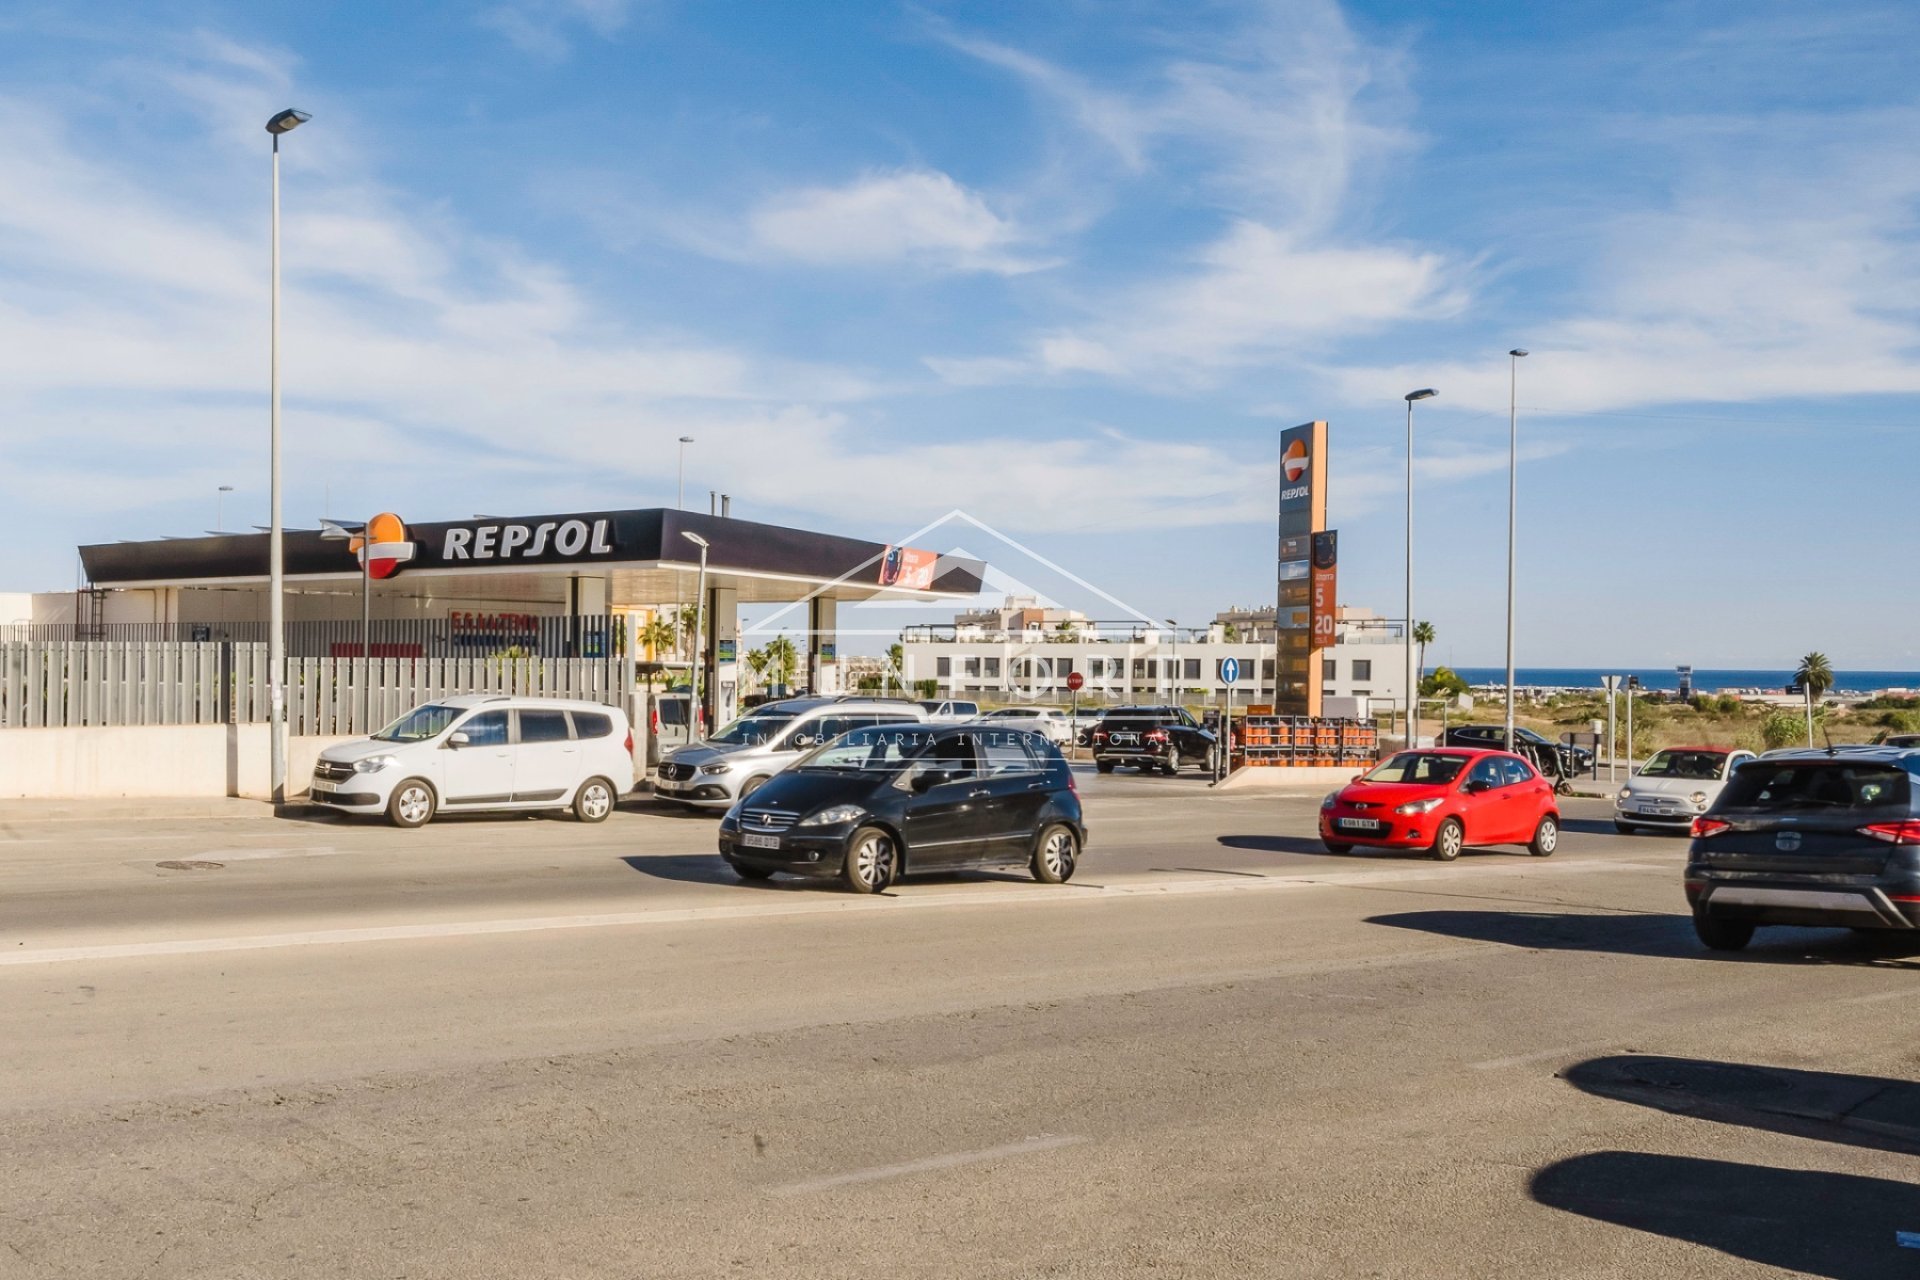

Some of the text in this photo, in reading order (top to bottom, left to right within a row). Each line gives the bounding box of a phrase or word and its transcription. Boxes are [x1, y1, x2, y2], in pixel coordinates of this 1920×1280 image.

[1281, 485, 1309, 501] REPSOL
[443, 519, 612, 560] REPSOL
[1315, 587, 1324, 608] 5
[1314, 614, 1333, 634] 20
